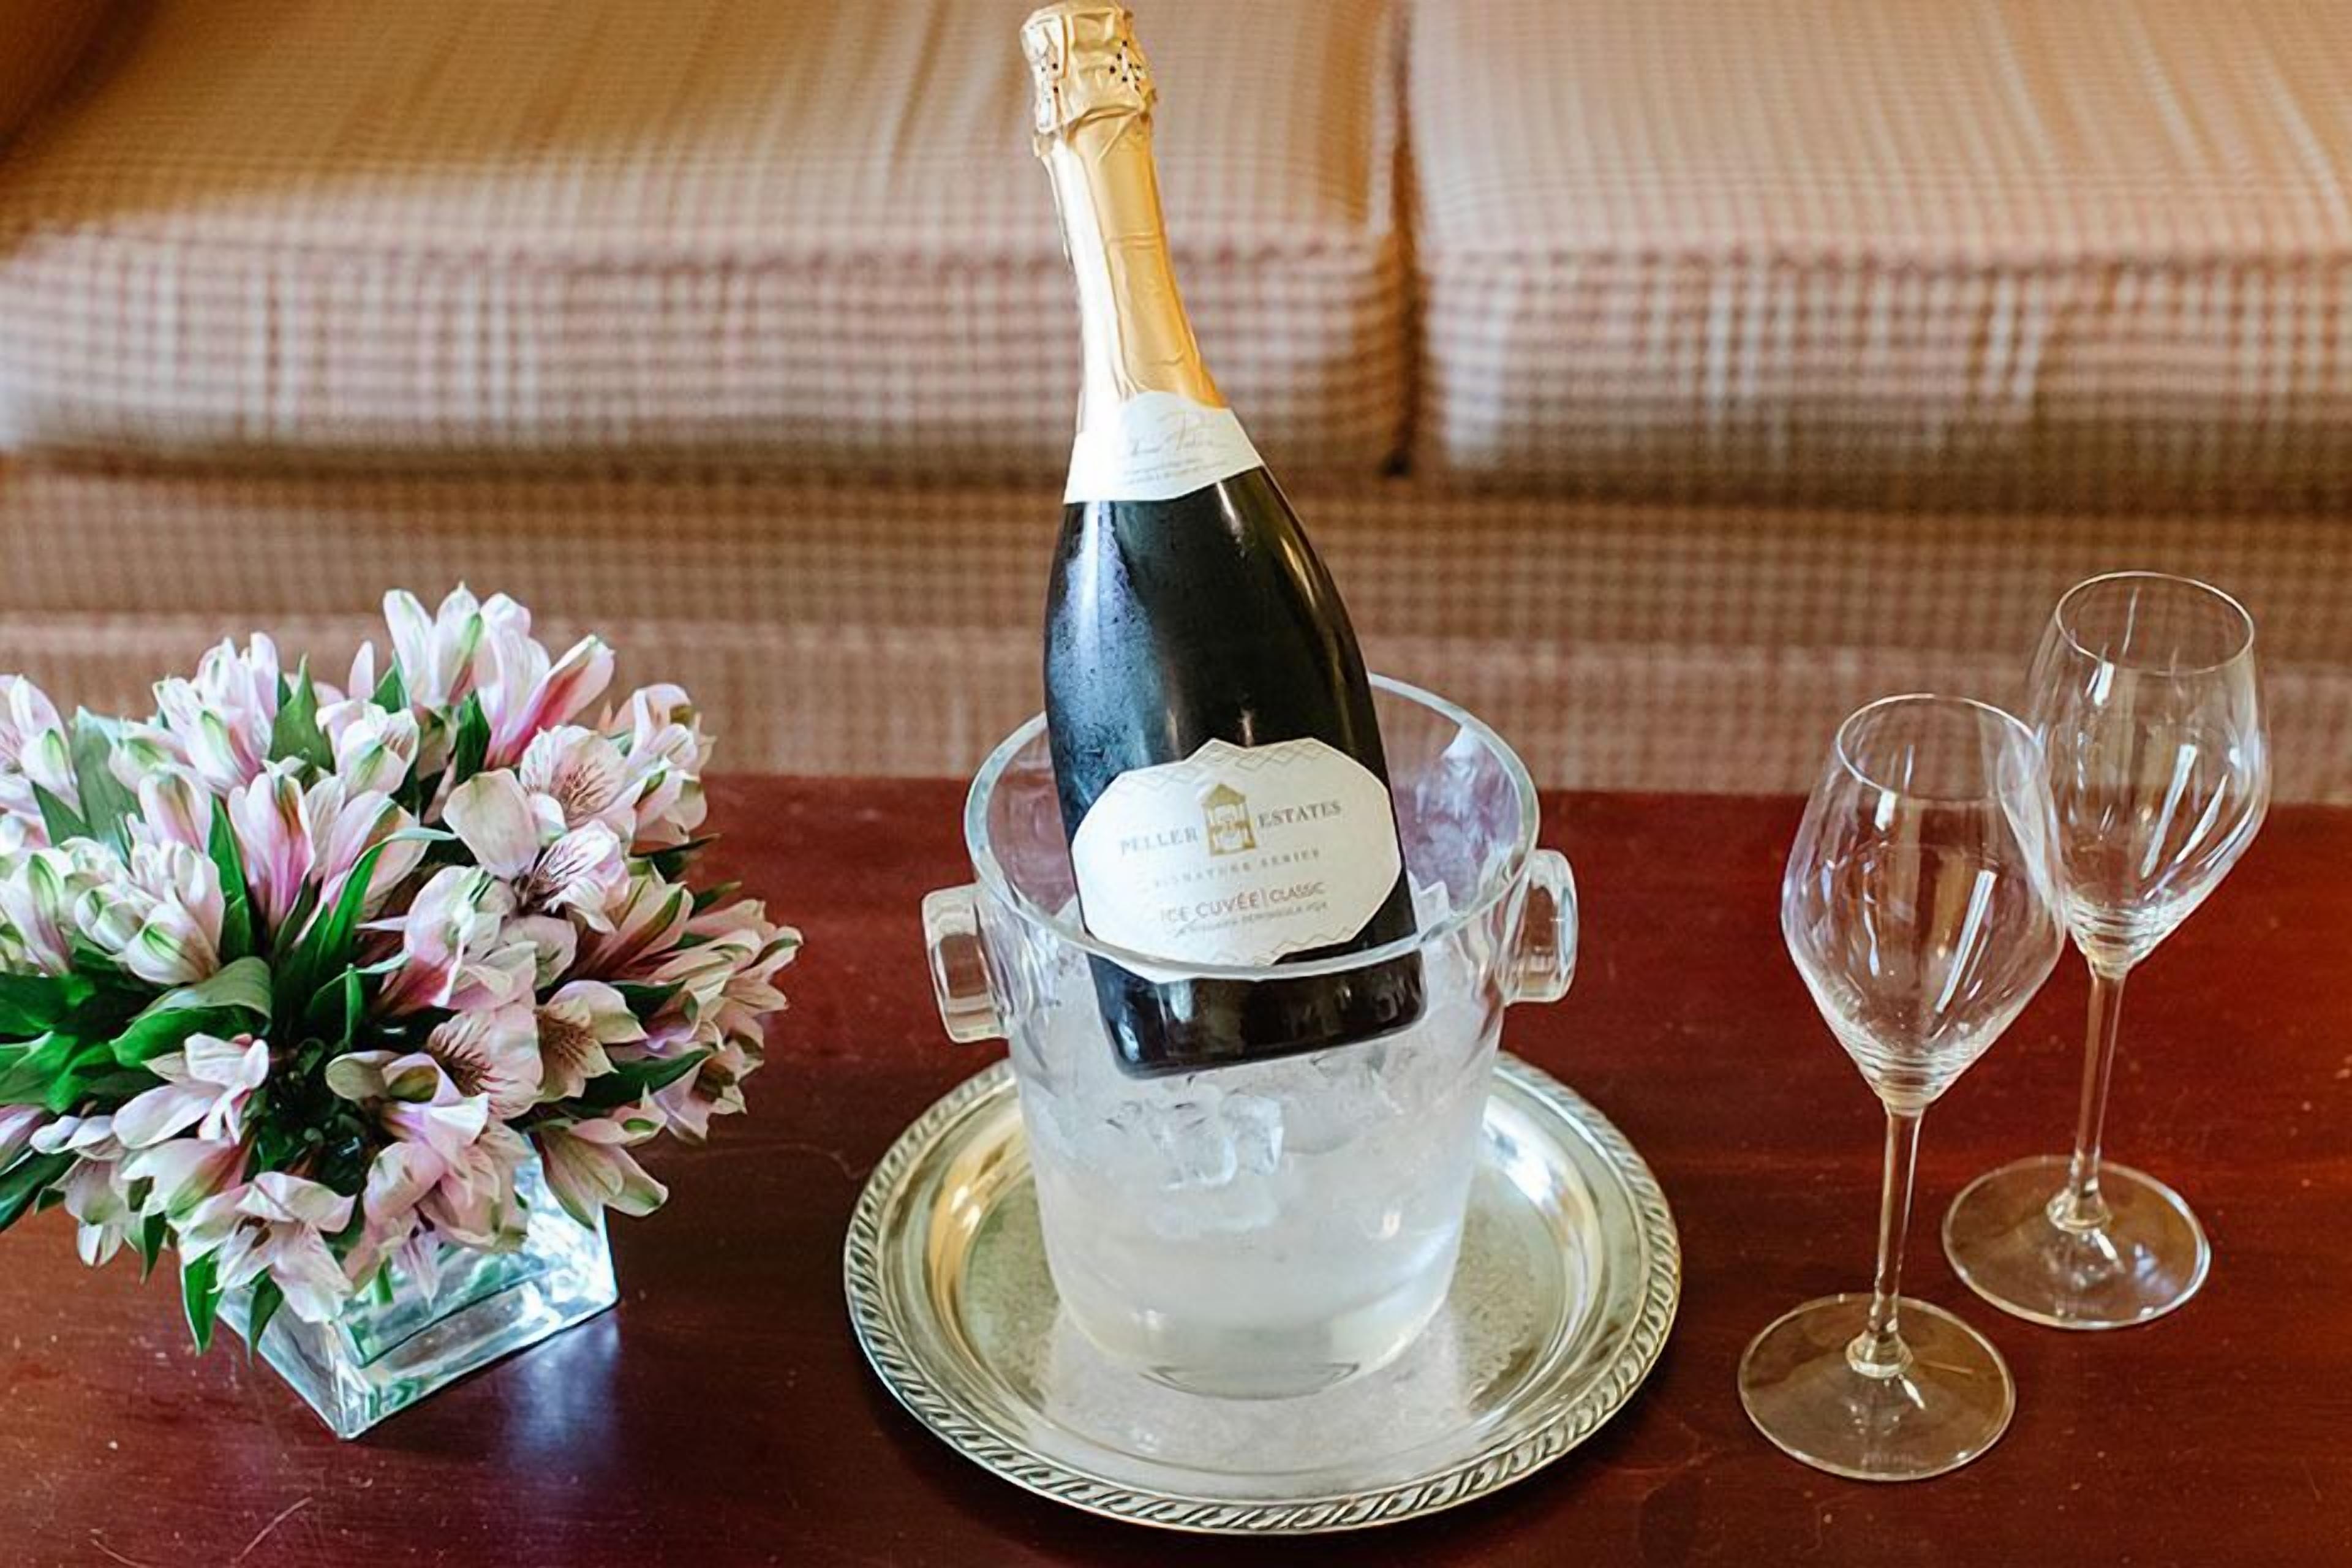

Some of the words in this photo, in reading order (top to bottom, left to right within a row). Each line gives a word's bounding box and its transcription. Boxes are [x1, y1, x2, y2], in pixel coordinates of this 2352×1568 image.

[1120, 827, 1198, 856] PELLER
[1258, 800, 1341, 829] ESTATES
[1161, 906, 1191, 922] ICE
